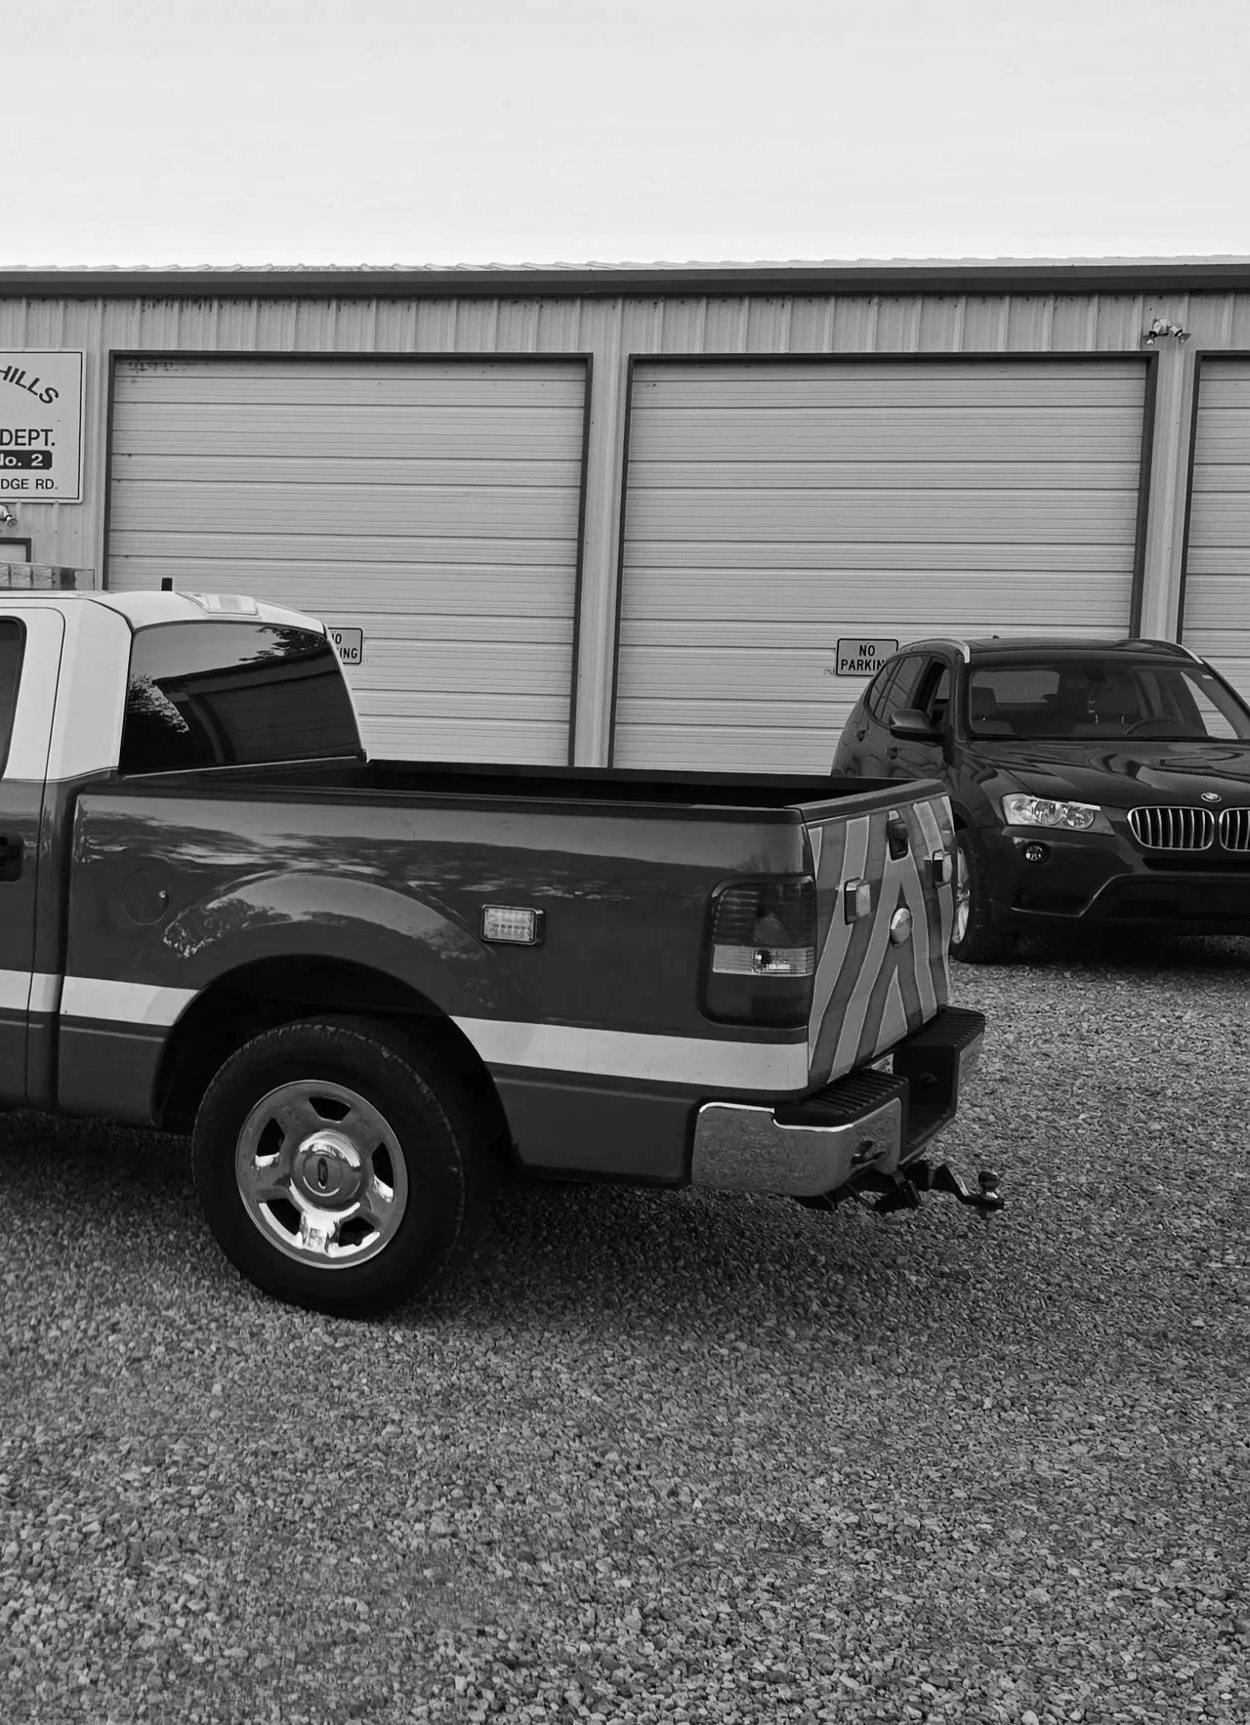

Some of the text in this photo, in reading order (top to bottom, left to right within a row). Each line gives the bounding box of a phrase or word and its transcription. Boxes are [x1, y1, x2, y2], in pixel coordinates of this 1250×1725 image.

[0, 428, 56, 447] DEPT.
[31, 453, 44, 467] 2
[35, 478, 58, 491] RD.
[332, 633, 342, 645] O
[859, 645, 876, 657] NO
[840, 658, 885, 672] PARKIN
